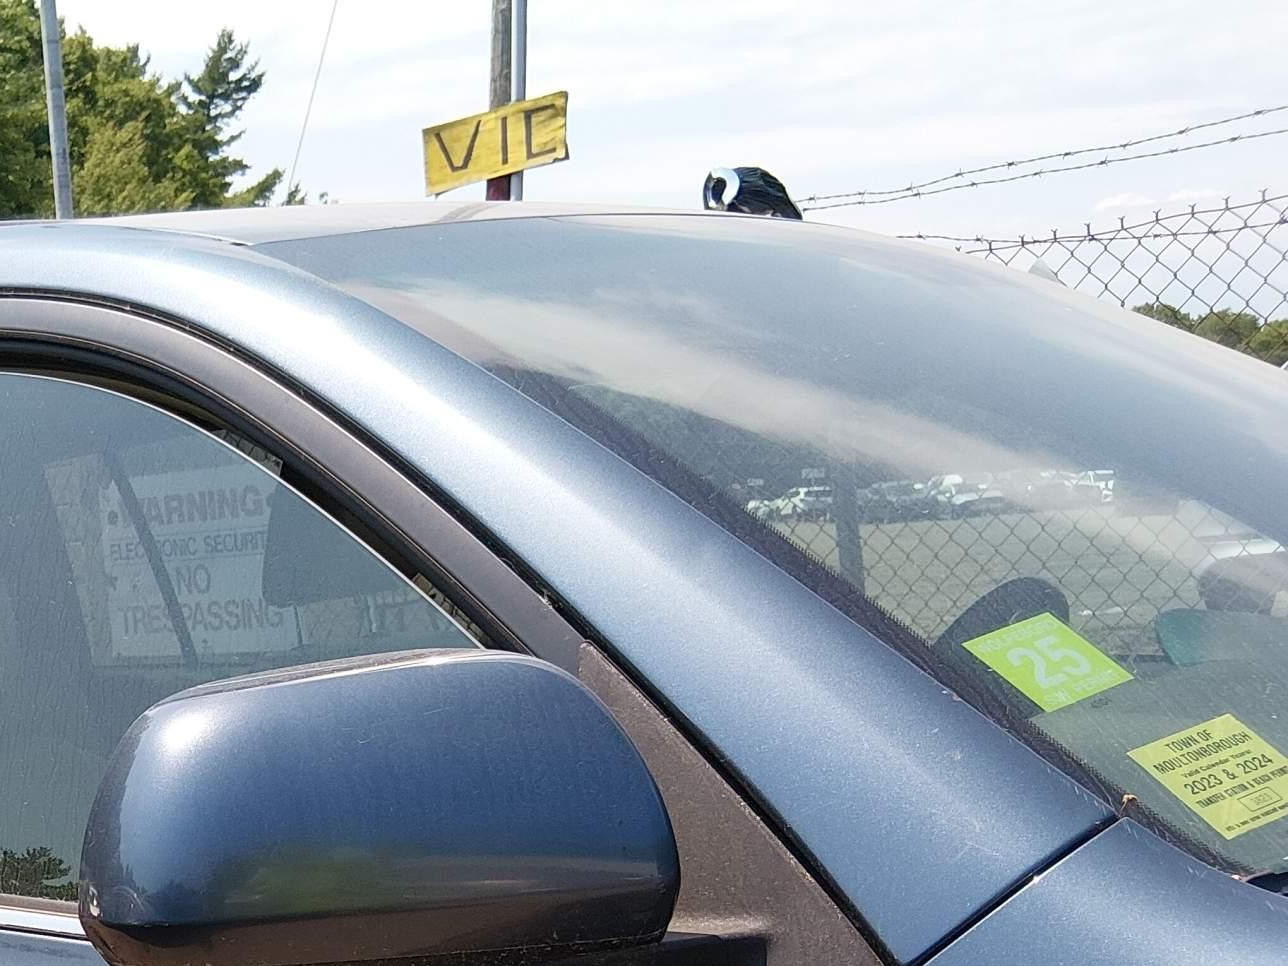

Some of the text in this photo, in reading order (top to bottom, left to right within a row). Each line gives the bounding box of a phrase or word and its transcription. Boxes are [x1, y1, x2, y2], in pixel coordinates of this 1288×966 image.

[434, 103, 561, 173] VIC
[140, 485, 266, 527] ARNING
[203, 531, 267, 554] SECURIT
[175, 563, 211, 595] NO
[1006, 635, 1092, 688] 25
[1153, 731, 1253, 775] MOULTONBOROUGH
[1164, 729, 1213, 754] TOWN OF
[1184, 753, 1274, 796] 2023 & 2024
